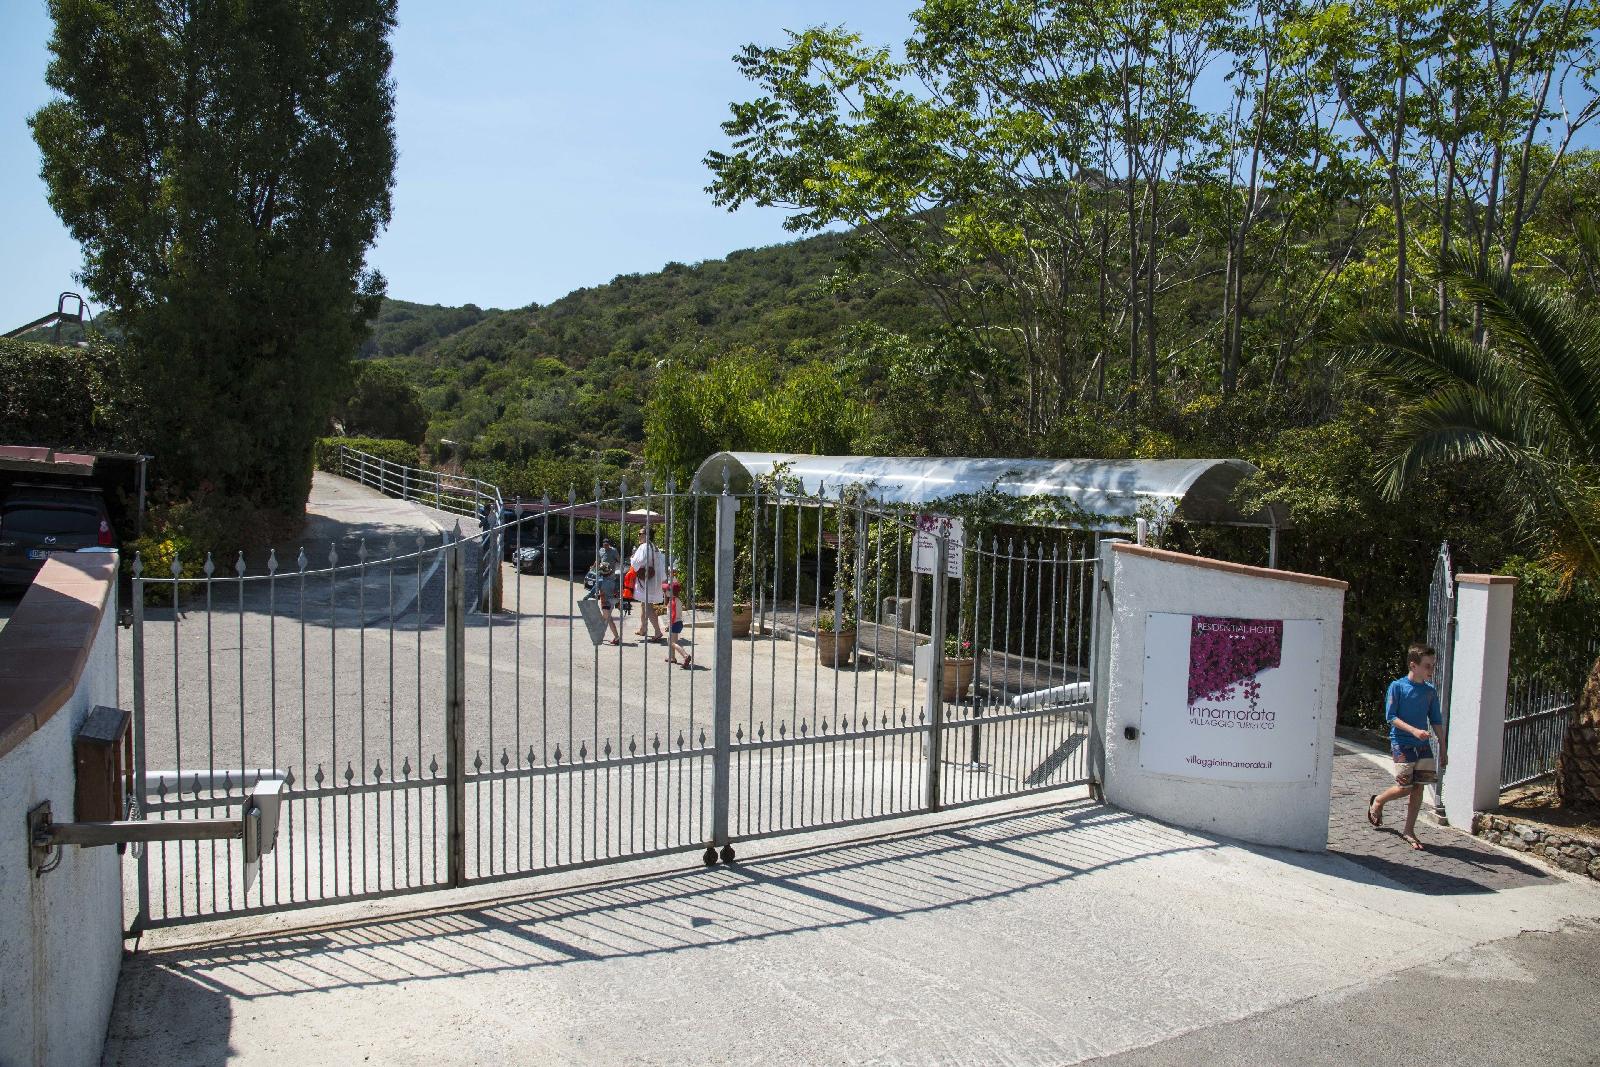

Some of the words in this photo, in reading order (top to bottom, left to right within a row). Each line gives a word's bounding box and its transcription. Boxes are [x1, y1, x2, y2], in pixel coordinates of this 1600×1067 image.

[1197, 622, 1247, 633] RESIDENTIAL
[1249, 625, 1275, 634] HOTEL
[1189, 706, 1276, 721] innamorata
[1190, 718, 1235, 728] VILLAGGIO
[1236, 721, 1275, 730] TURISTICO
[1186, 755, 1272, 769] villaggioinnamorata.it
